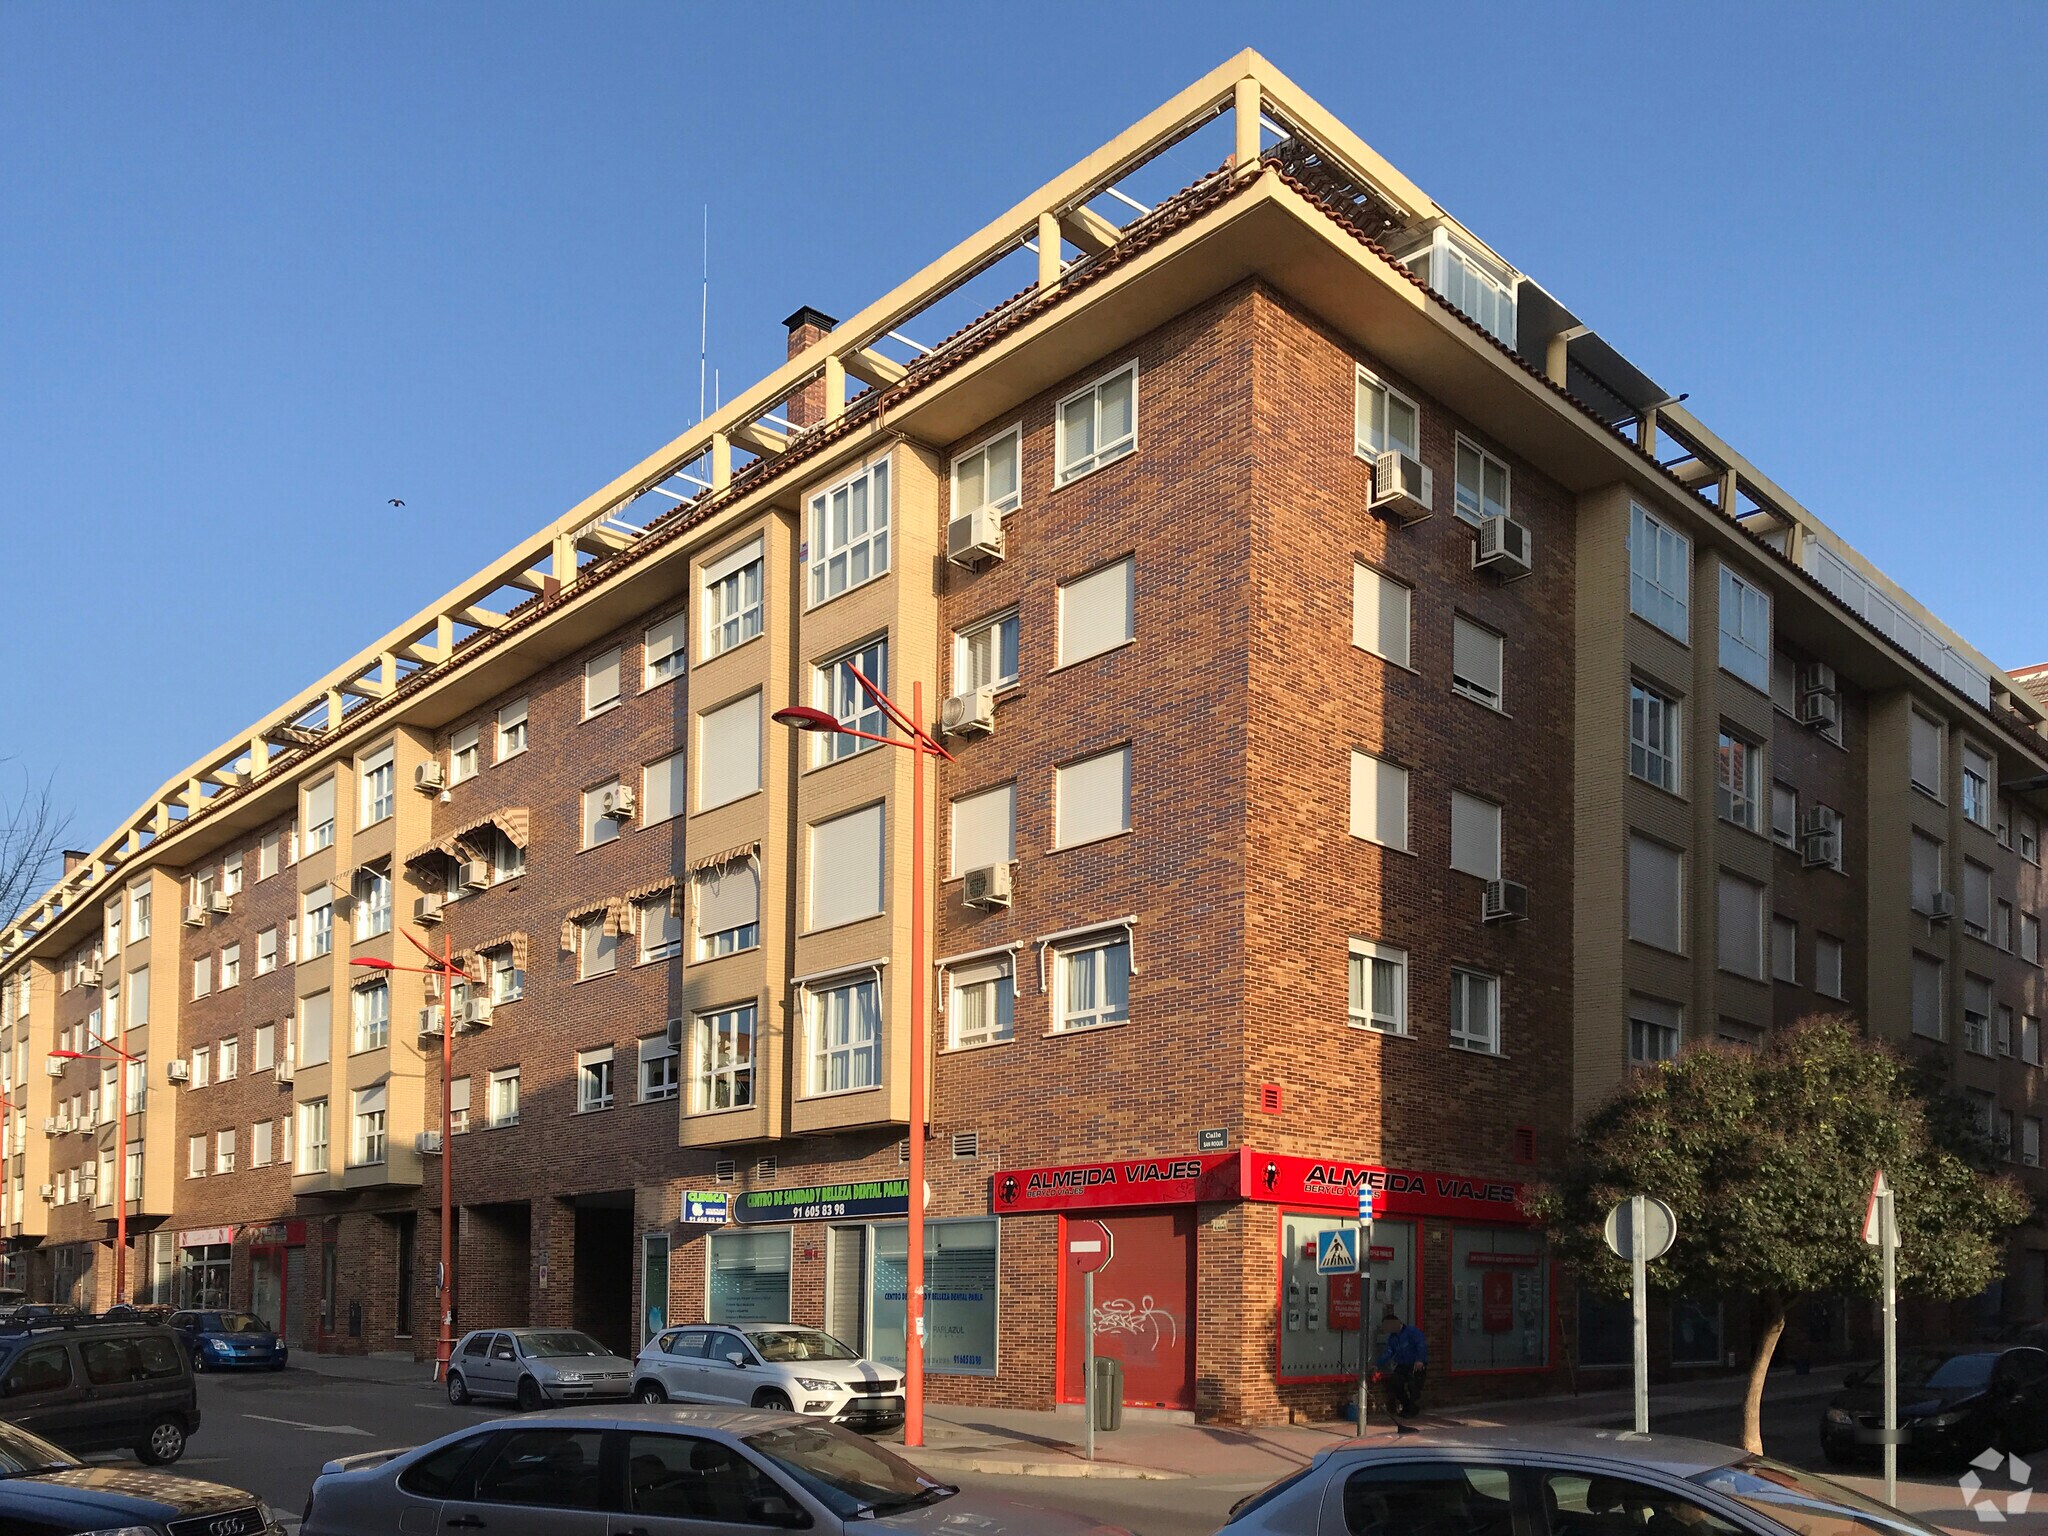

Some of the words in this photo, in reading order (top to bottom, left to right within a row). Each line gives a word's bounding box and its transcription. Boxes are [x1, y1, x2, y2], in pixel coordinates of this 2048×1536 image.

[1027, 1167, 1117, 1190] ALMEIDA
[1125, 1160, 1201, 1183] VIAJES
[1303, 1164, 1426, 1195] ALMEIDA
[1436, 1178, 1516, 1204] VIAJES
[746, 1193, 772, 1208] CENTRO
[773, 1191, 783, 1206] DE
[784, 1188, 815, 1205] SANIDAD
[814, 1187, 821, 1203] Y
[822, 1184, 852, 1203] BELLEZA
[853, 1182, 883, 1200] DENTAL
[883, 1181, 908, 1198] PARLA
[1027, 1189, 1057, 1198] BERYLO
[1057, 1187, 1084, 1196] VIAJES
[1304, 1184, 1344, 1195] BERYLO
[793, 1206, 803, 1218] 91
[804, 1205, 820, 1218] 605
[821, 1204, 833, 1216] 83
[834, 1203, 845, 1216] 98
